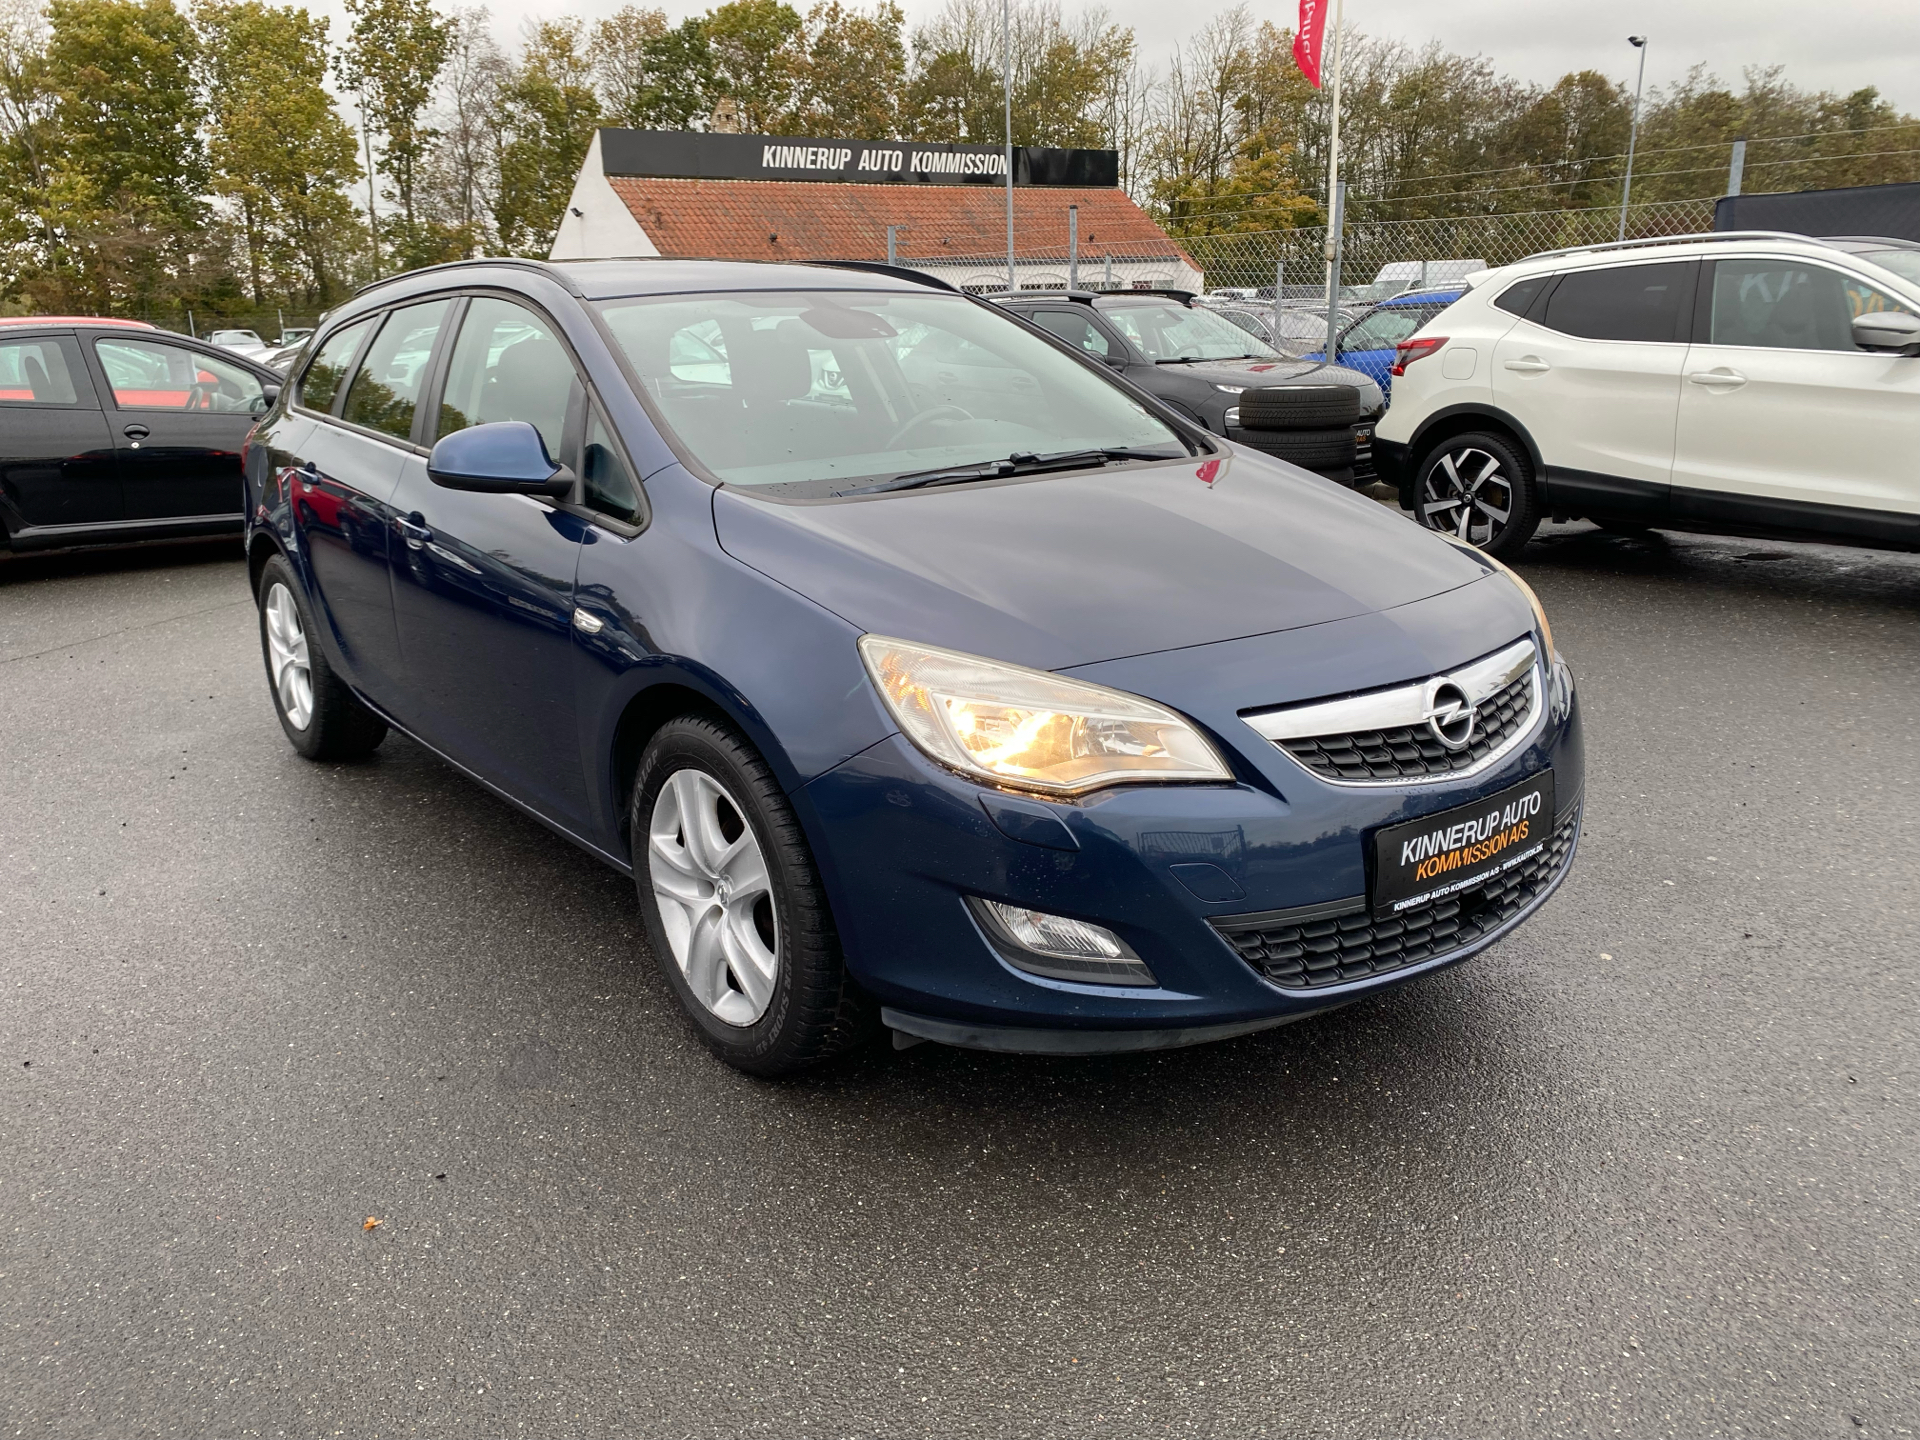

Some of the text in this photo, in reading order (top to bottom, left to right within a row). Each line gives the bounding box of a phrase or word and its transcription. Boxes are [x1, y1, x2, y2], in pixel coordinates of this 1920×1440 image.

[762, 145, 1007, 175] KINNERUP AUTO KOMMISSION
[632, 748, 658, 826] DUNLOP
[1400, 791, 1541, 867] KINNERUP AUTO
[1416, 820, 1530, 881] KOMMISSION A/S
[1394, 893, 1431, 912] KINNERUP
[1430, 885, 1450, 901] AUTO
[1450, 873, 1489, 893] KOMMISSION
[780, 904, 792, 991] WINTER
[768, 993, 790, 1046] SPORT
